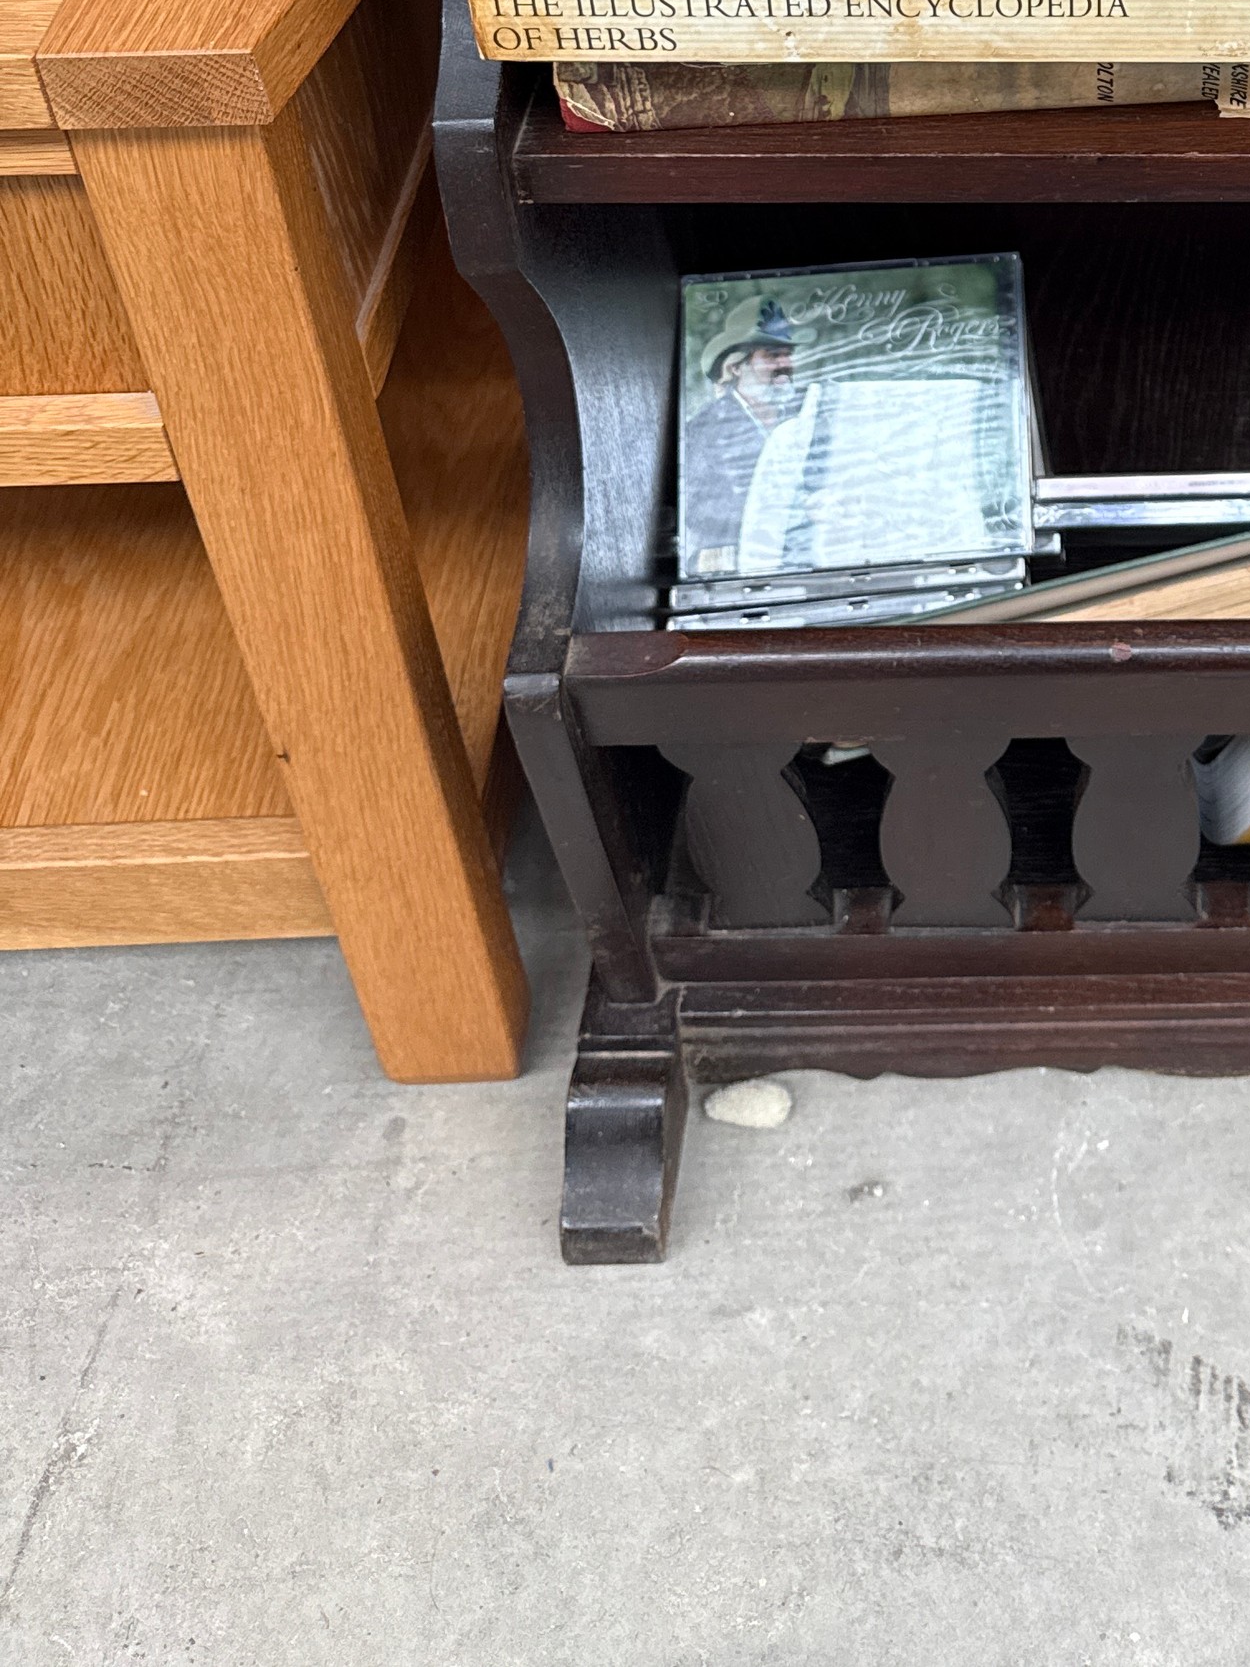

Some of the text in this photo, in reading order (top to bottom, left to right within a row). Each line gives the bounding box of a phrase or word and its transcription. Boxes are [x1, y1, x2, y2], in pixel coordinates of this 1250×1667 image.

[492, 26, 678, 52] OF HERBS
[1096, 63, 1114, 102] OLTON
[1230, 63, 1250, 109] KSHIRE
[788, 285, 907, 325] Kenny
[858, 304, 1003, 355] Rogers
